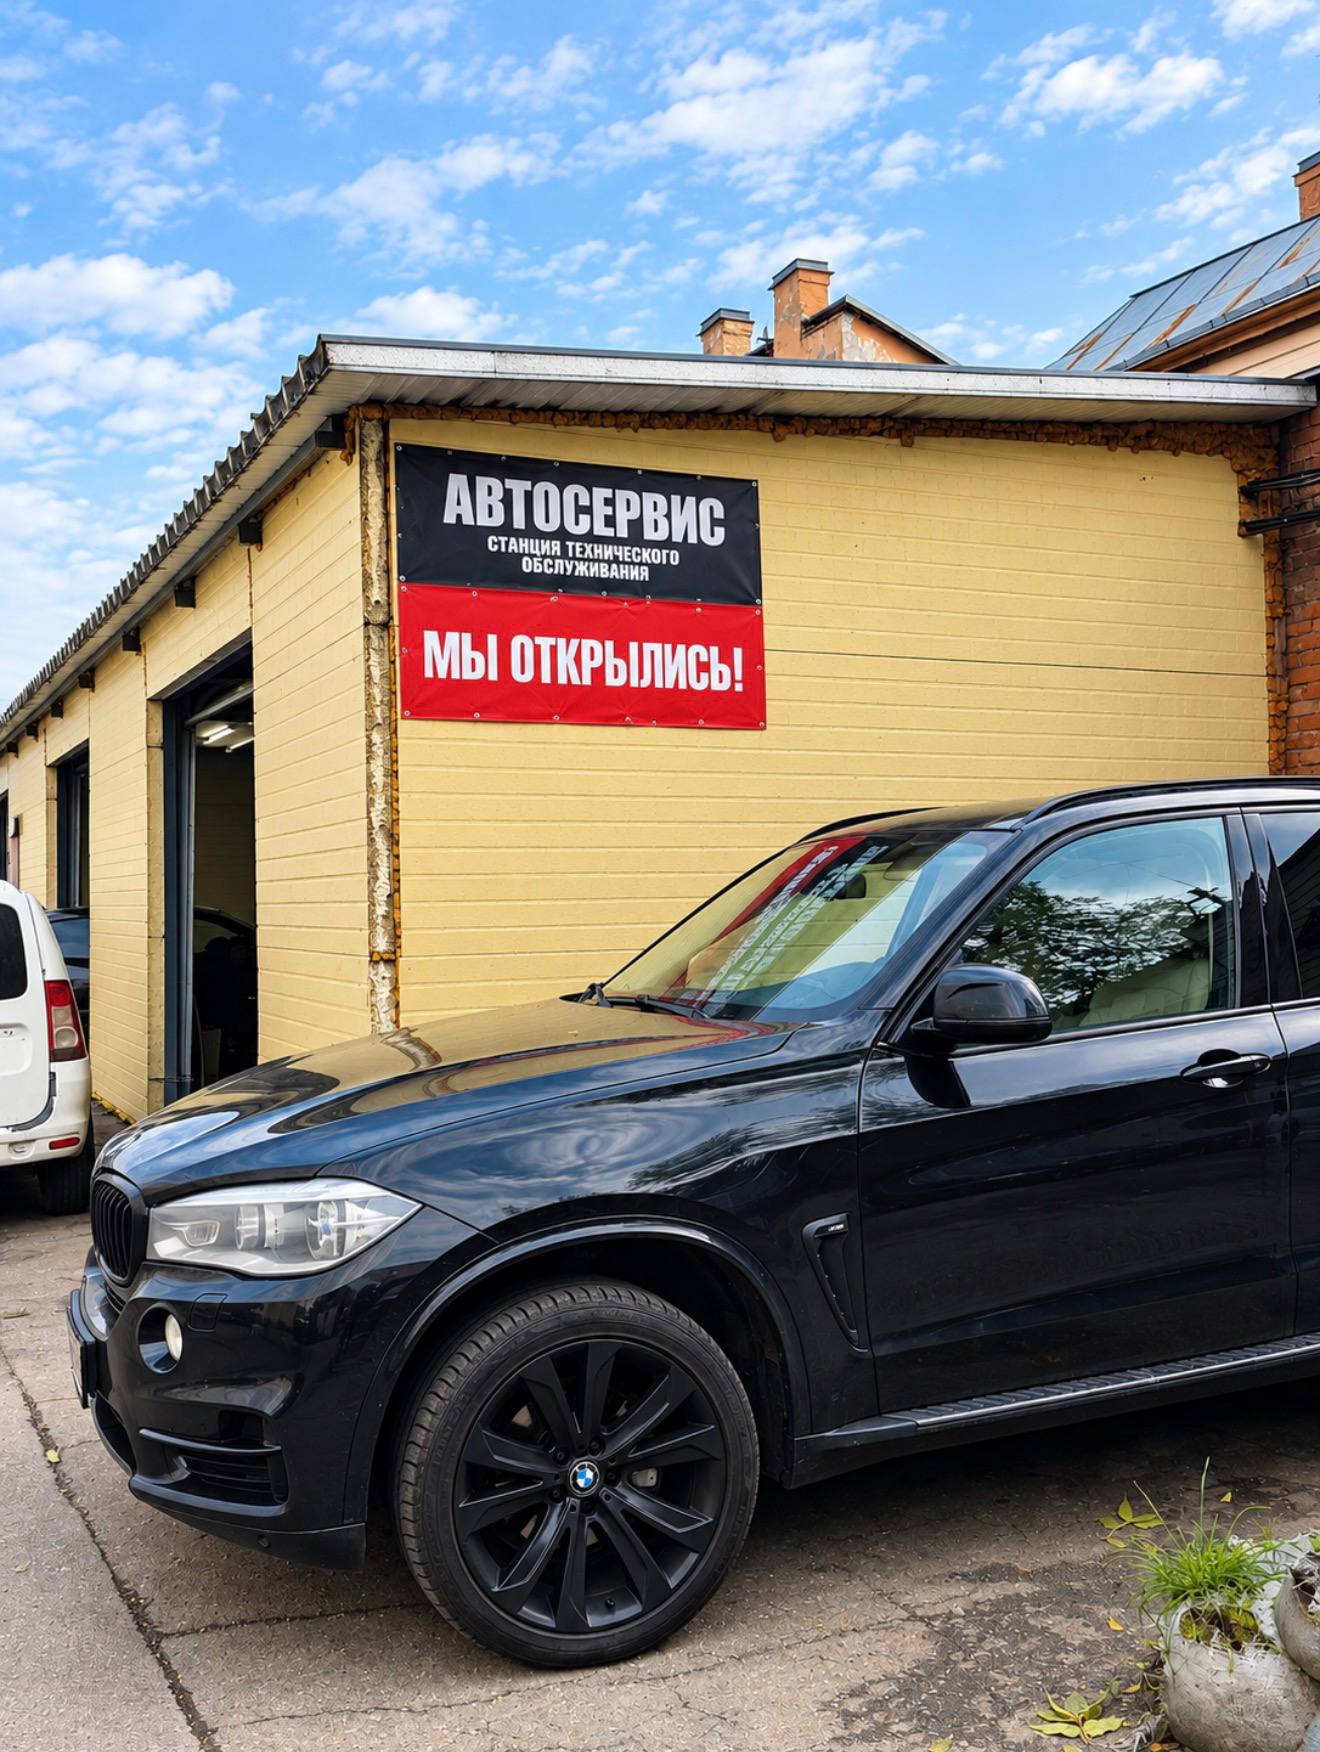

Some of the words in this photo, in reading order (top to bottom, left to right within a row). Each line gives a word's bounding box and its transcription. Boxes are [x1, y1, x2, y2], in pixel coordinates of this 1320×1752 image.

[443, 473, 725, 546] АВТОСЕРВИС
[487, 535, 561, 557] СТАНЦИЯ
[565, 541, 680, 566] ТЕХНИЧЕСКОГО
[521, 556, 650, 582] ОБСЛУЖИВАНИЯ
[423, 630, 498, 681] МЫ
[510, 635, 744, 692] ОТКРЫЛИСЬ!
